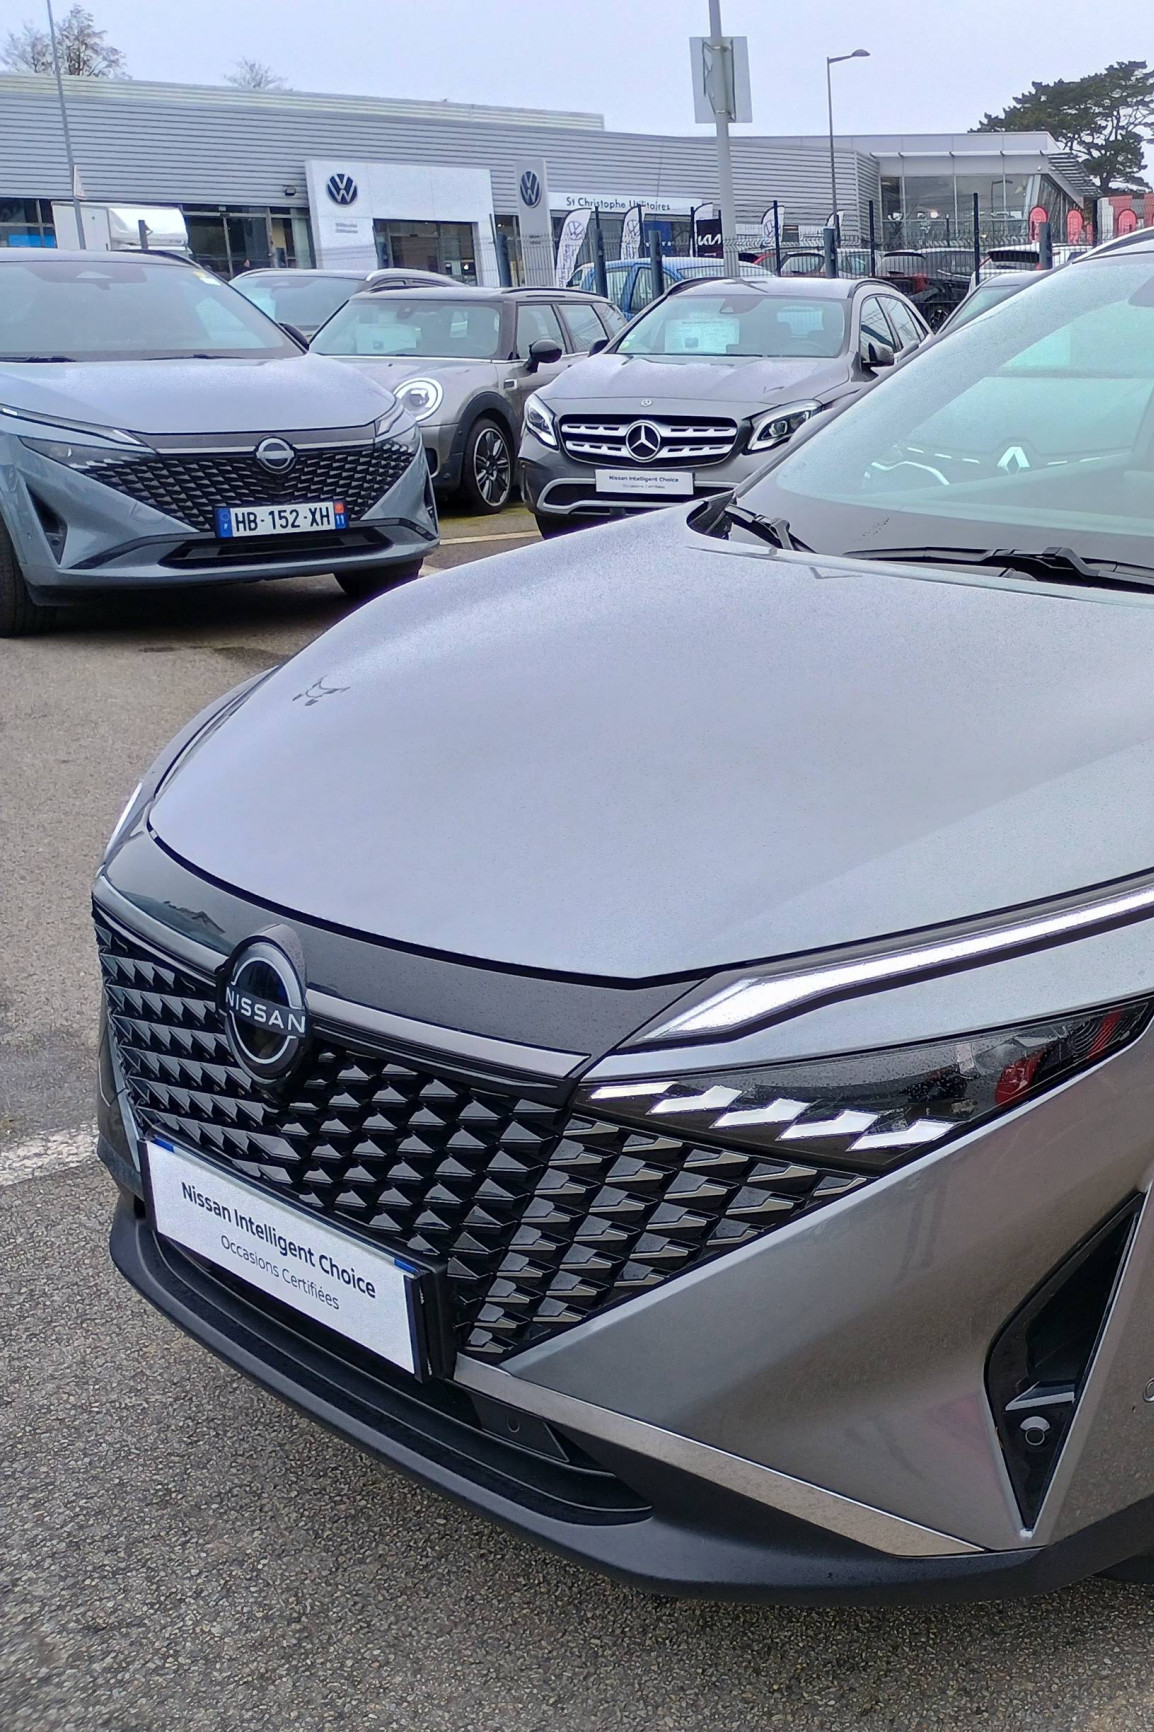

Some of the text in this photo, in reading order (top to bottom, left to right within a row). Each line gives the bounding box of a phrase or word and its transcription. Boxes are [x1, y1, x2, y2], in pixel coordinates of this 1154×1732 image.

[578, 197, 626, 210] Christophe
[335, 515, 345, 525] 11
[225, 986, 306, 1033] NISSAN
[181, 1181, 376, 1299] Nissan Intelligent Choice
[220, 1234, 340, 1310] Occasions Certifiées
